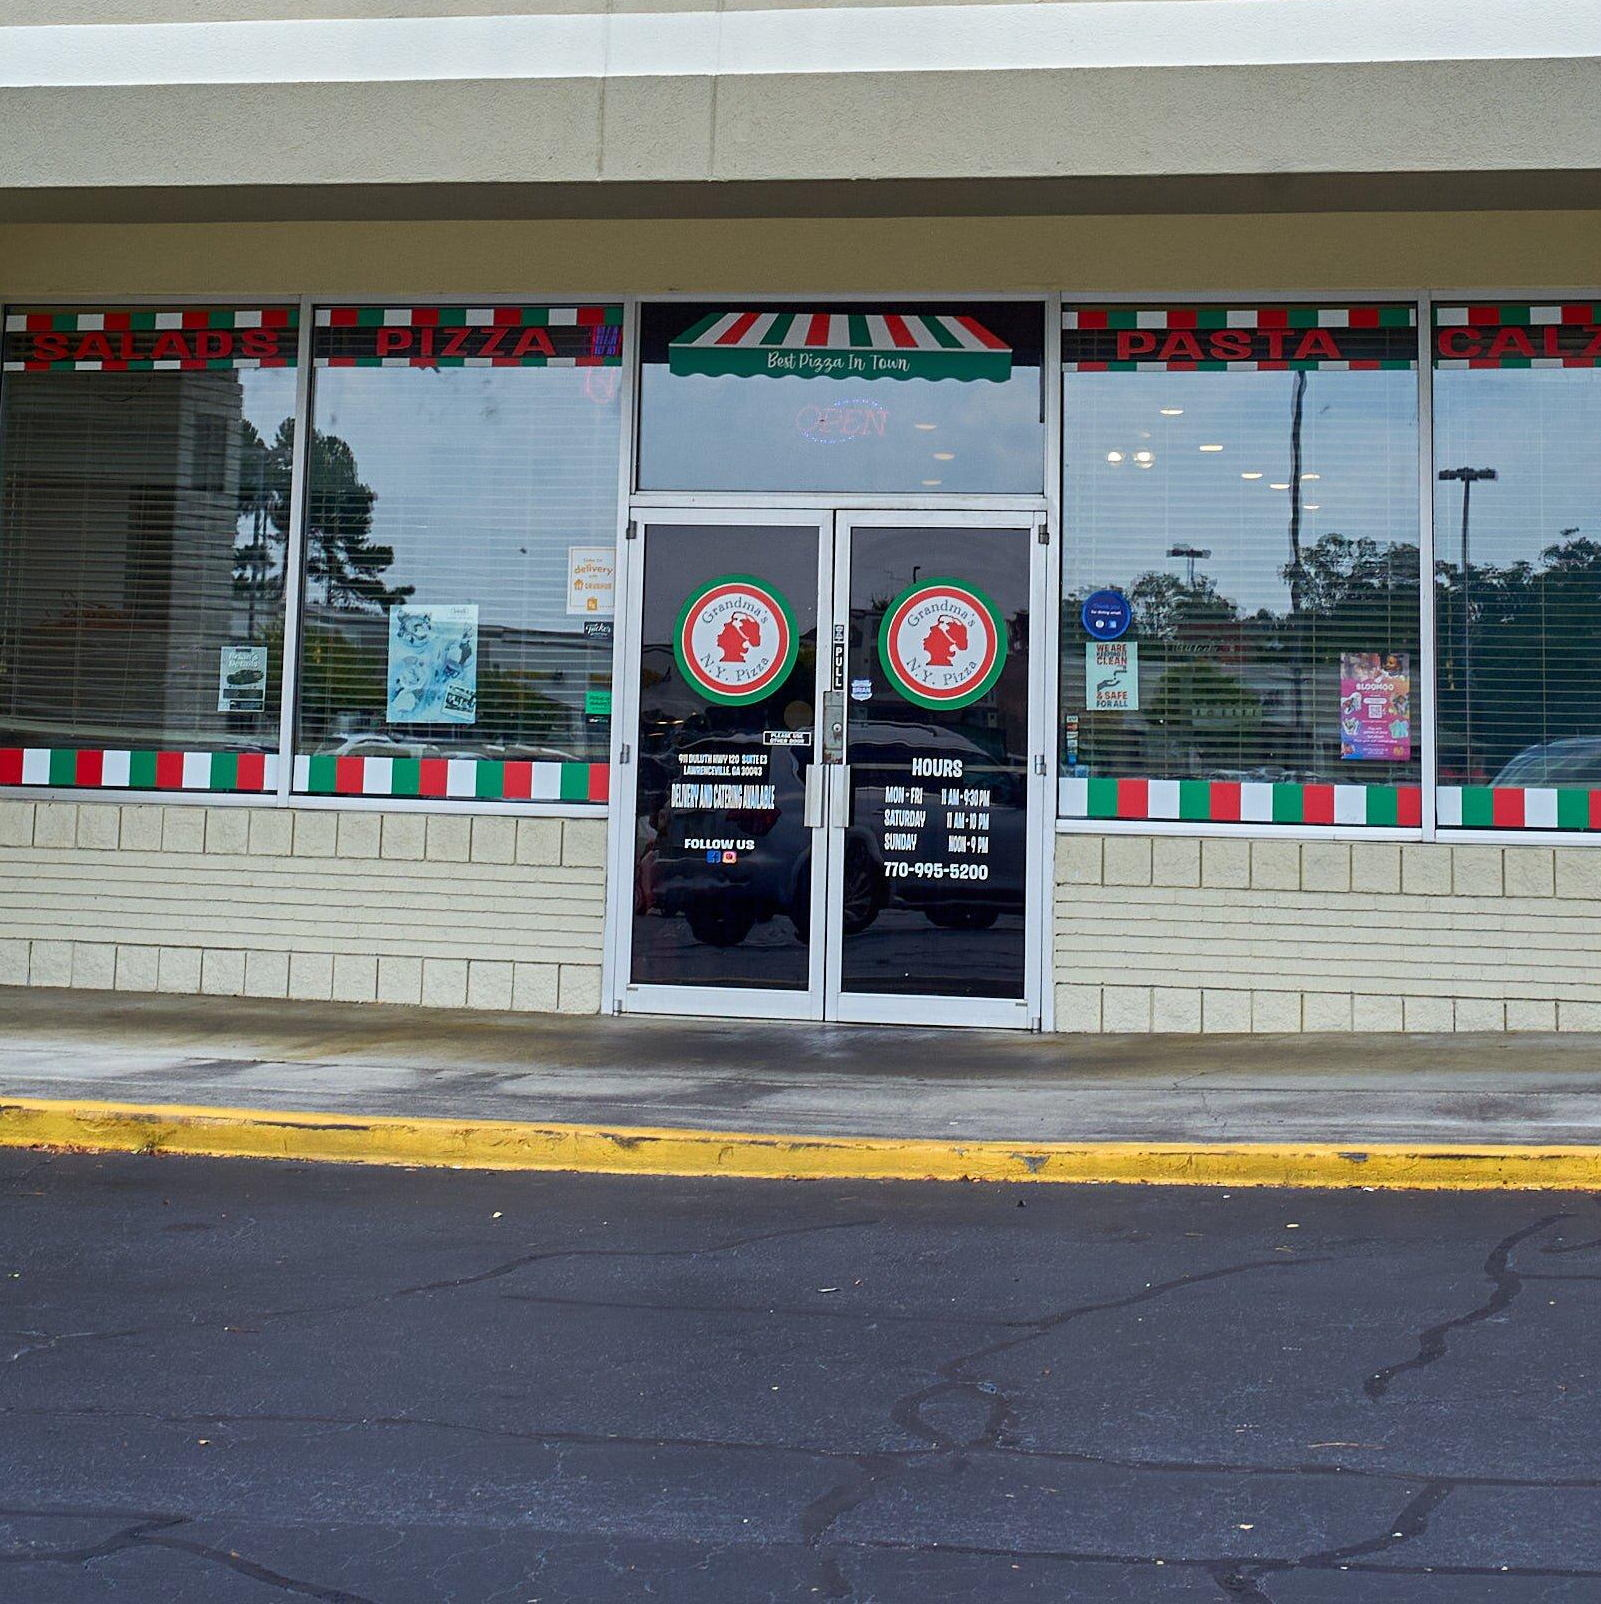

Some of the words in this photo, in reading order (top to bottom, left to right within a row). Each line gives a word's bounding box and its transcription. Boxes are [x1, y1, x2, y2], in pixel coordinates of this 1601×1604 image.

[32, 328, 279, 360] SALADS
[376, 327, 557, 357] PIZZA
[1116, 328, 1342, 361] PASTA
[767, 350, 797, 370] Best
[799, 353, 845, 373] Pizza
[848, 354, 866, 371] In
[871, 354, 910, 372] Town
[796, 404, 890, 437] OPEN
[701, 596, 769, 624] Grandma's
[907, 599, 976, 627] Grandma's
[1096, 643, 1109, 652] WE
[1111, 643, 1127, 652] ARE
[700, 653, 729, 681] N.Y.
[735, 656, 769, 682] Pizza
[835, 646, 843, 687] PULL
[906, 657, 936, 685] N.Y.
[943, 660, 977, 686] Pizza
[1096, 656, 1127, 666] CLEAN
[1104, 691, 1128, 700] SAFE
[689, 754, 712, 764] DULUTH
[713, 754, 728, 764] HWY
[728, 754, 739, 765] 120
[742, 754, 760, 765] SUITE
[732, 765, 740, 776] GA
[911, 757, 963, 778] HOURS
[671, 783, 699, 808] DELIVERY
[699, 783, 713, 809] AND
[713, 784, 742, 809] CATERING
[743, 784, 775, 810] AVAILABLE
[979, 789, 990, 807] PM
[884, 809, 926, 828] SATURDAY
[978, 813, 989, 830] PM
[684, 838, 734, 850] FOLLOW
[736, 839, 755, 850] US
[884, 832, 917, 851] SUNDAY
[977, 836, 989, 853] PM
[883, 861, 989, 880] 770-995-5200
